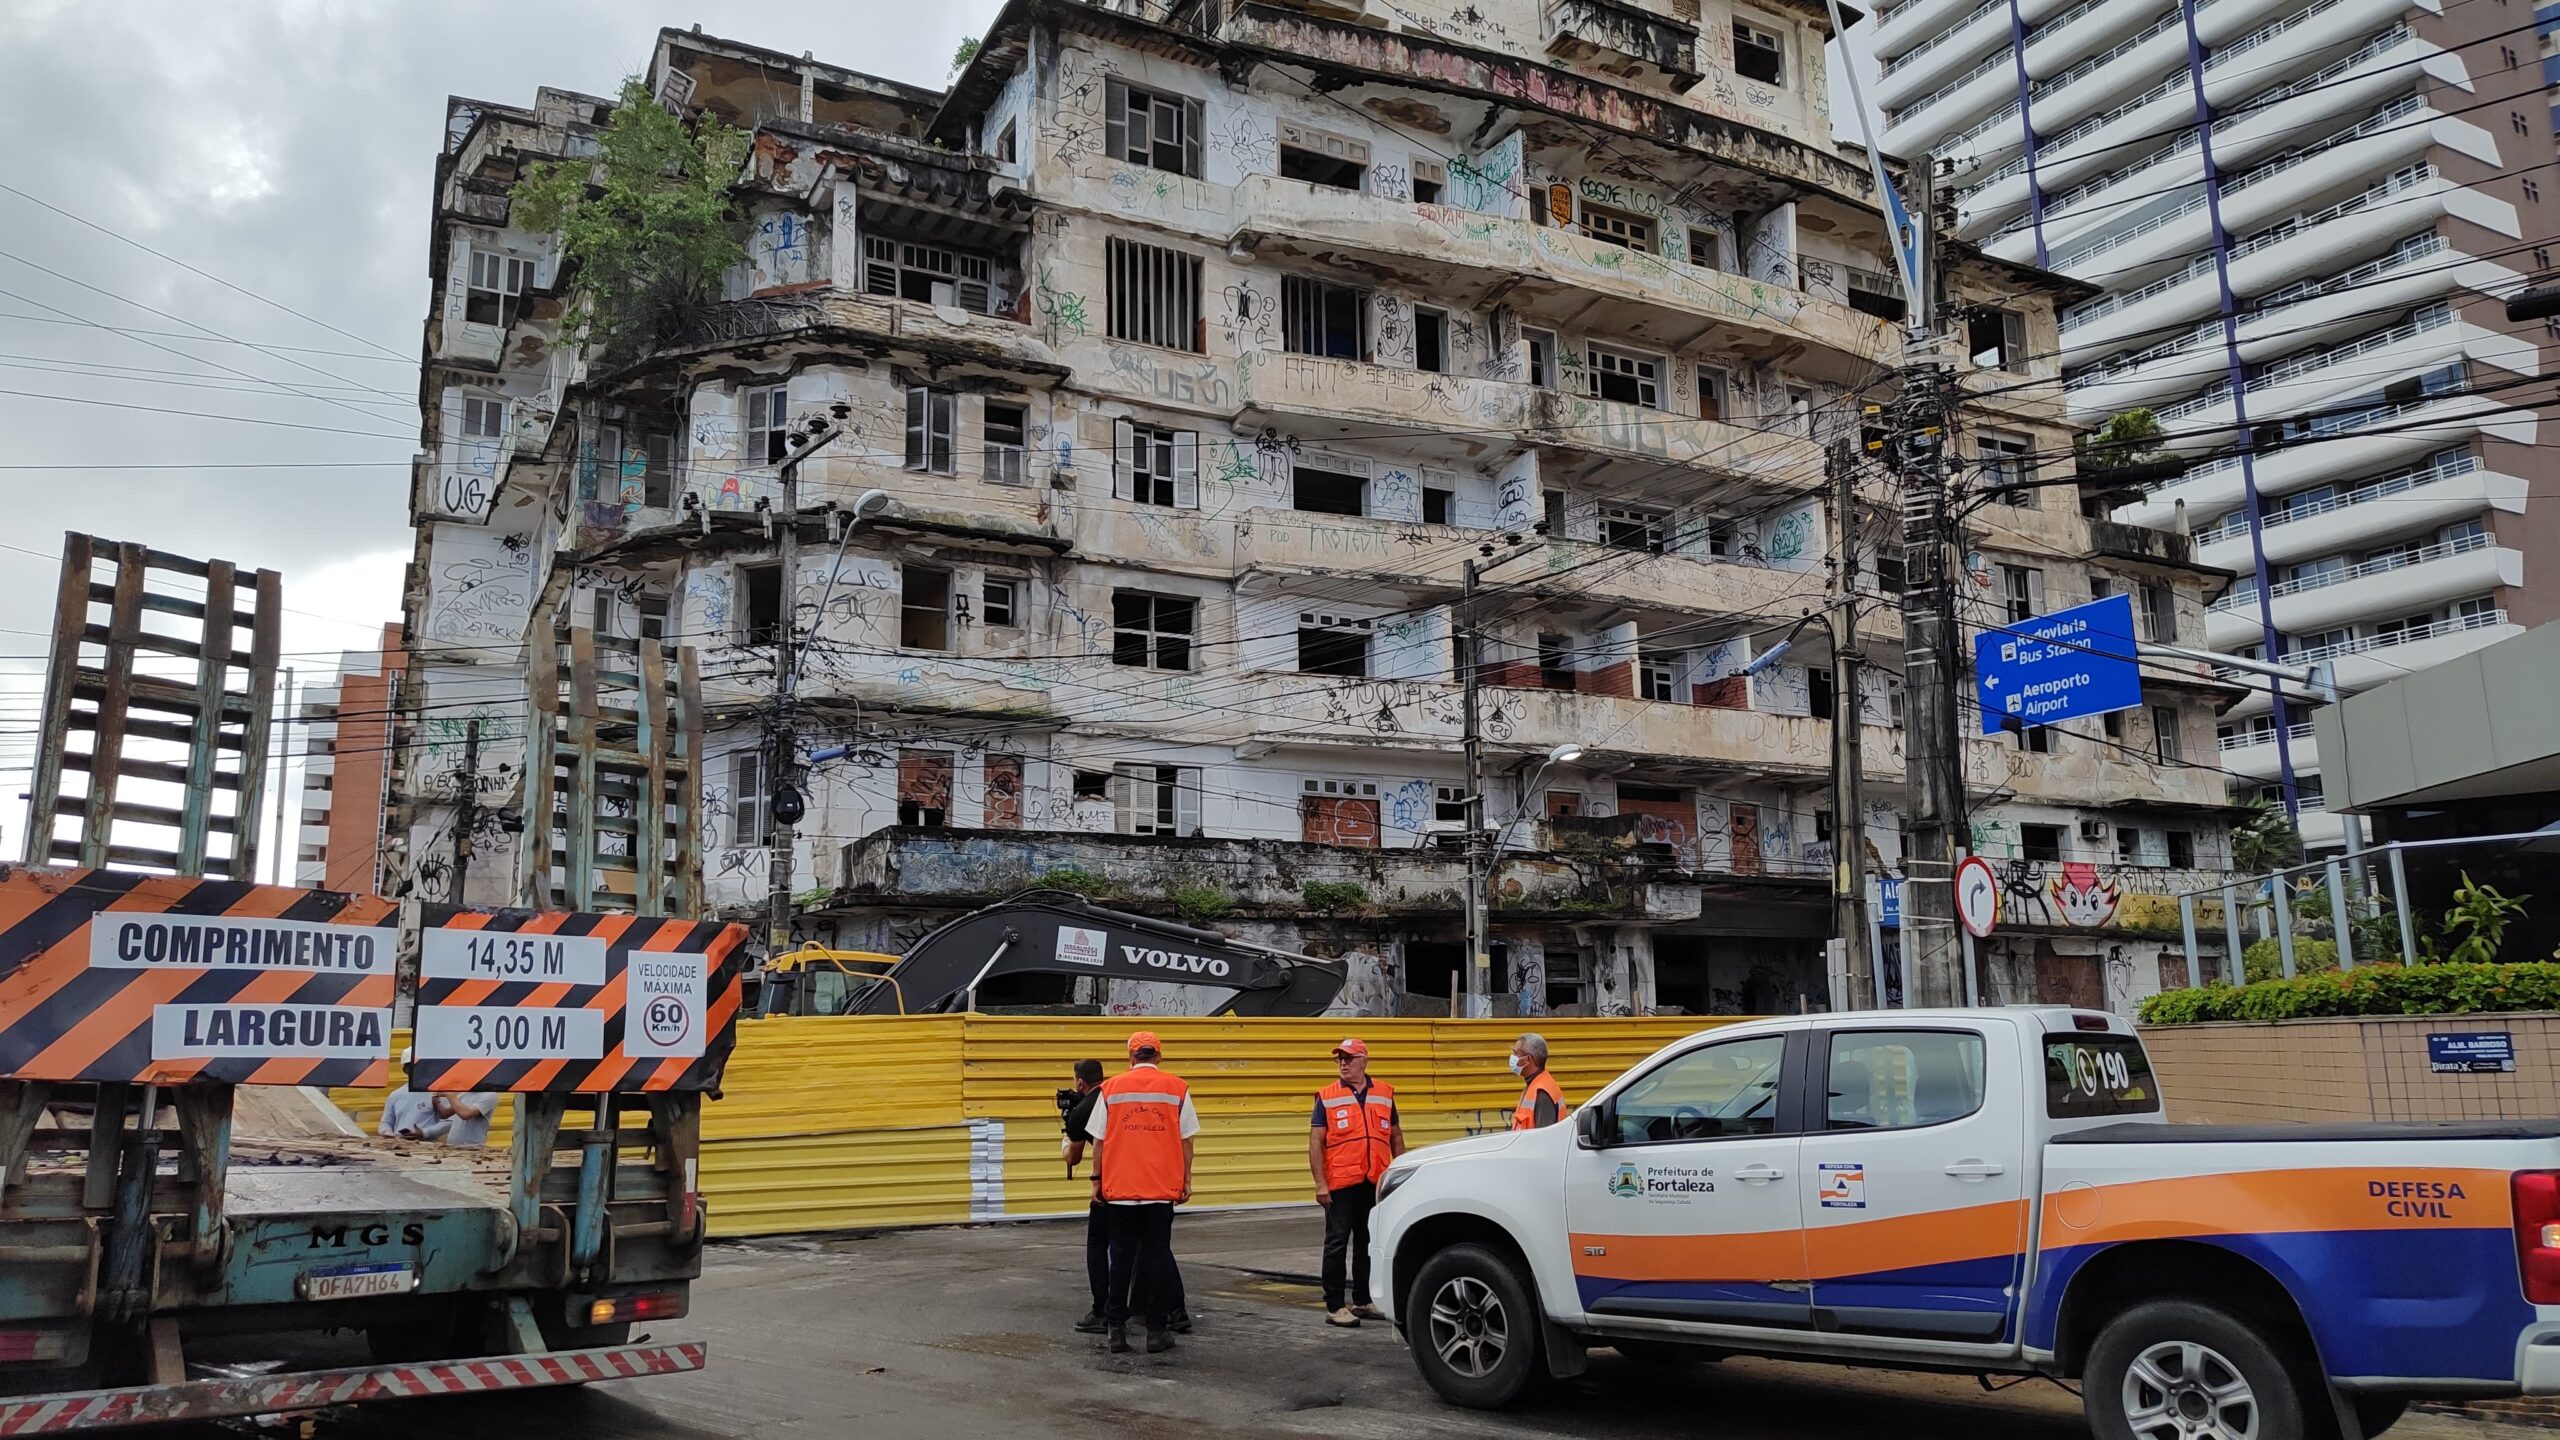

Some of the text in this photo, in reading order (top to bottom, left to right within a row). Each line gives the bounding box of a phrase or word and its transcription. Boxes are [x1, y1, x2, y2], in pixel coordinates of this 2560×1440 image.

[2019, 637, 2091, 665] Bus Station
[2023, 673, 2090, 698] Aeroporto
[2025, 695, 2068, 716] Airport
[118, 922, 375, 970] COMPRIMENTO
[467, 936, 564, 981] 14,35 M
[1120, 945, 1230, 977] VOLVO
[638, 962, 697, 979] VELOCIDADE
[643, 978, 693, 995] MÁXIMA
[650, 1003, 683, 1024] 60
[183, 1009, 383, 1047] LARGURA
[467, 1014, 566, 1056] 3,00 M
[652, 1023, 681, 1033] Km/h
[2096, 1052, 2129, 1090] 190
[1124, 1123, 1166, 1132] FORTALEZA
[1648, 1166, 1714, 1177] Prefeitura de
[1648, 1178, 1715, 1193] Fortaleza
[2368, 1180, 2466, 1200] DEFESA
[2386, 1200, 2452, 1218] CIVIL
